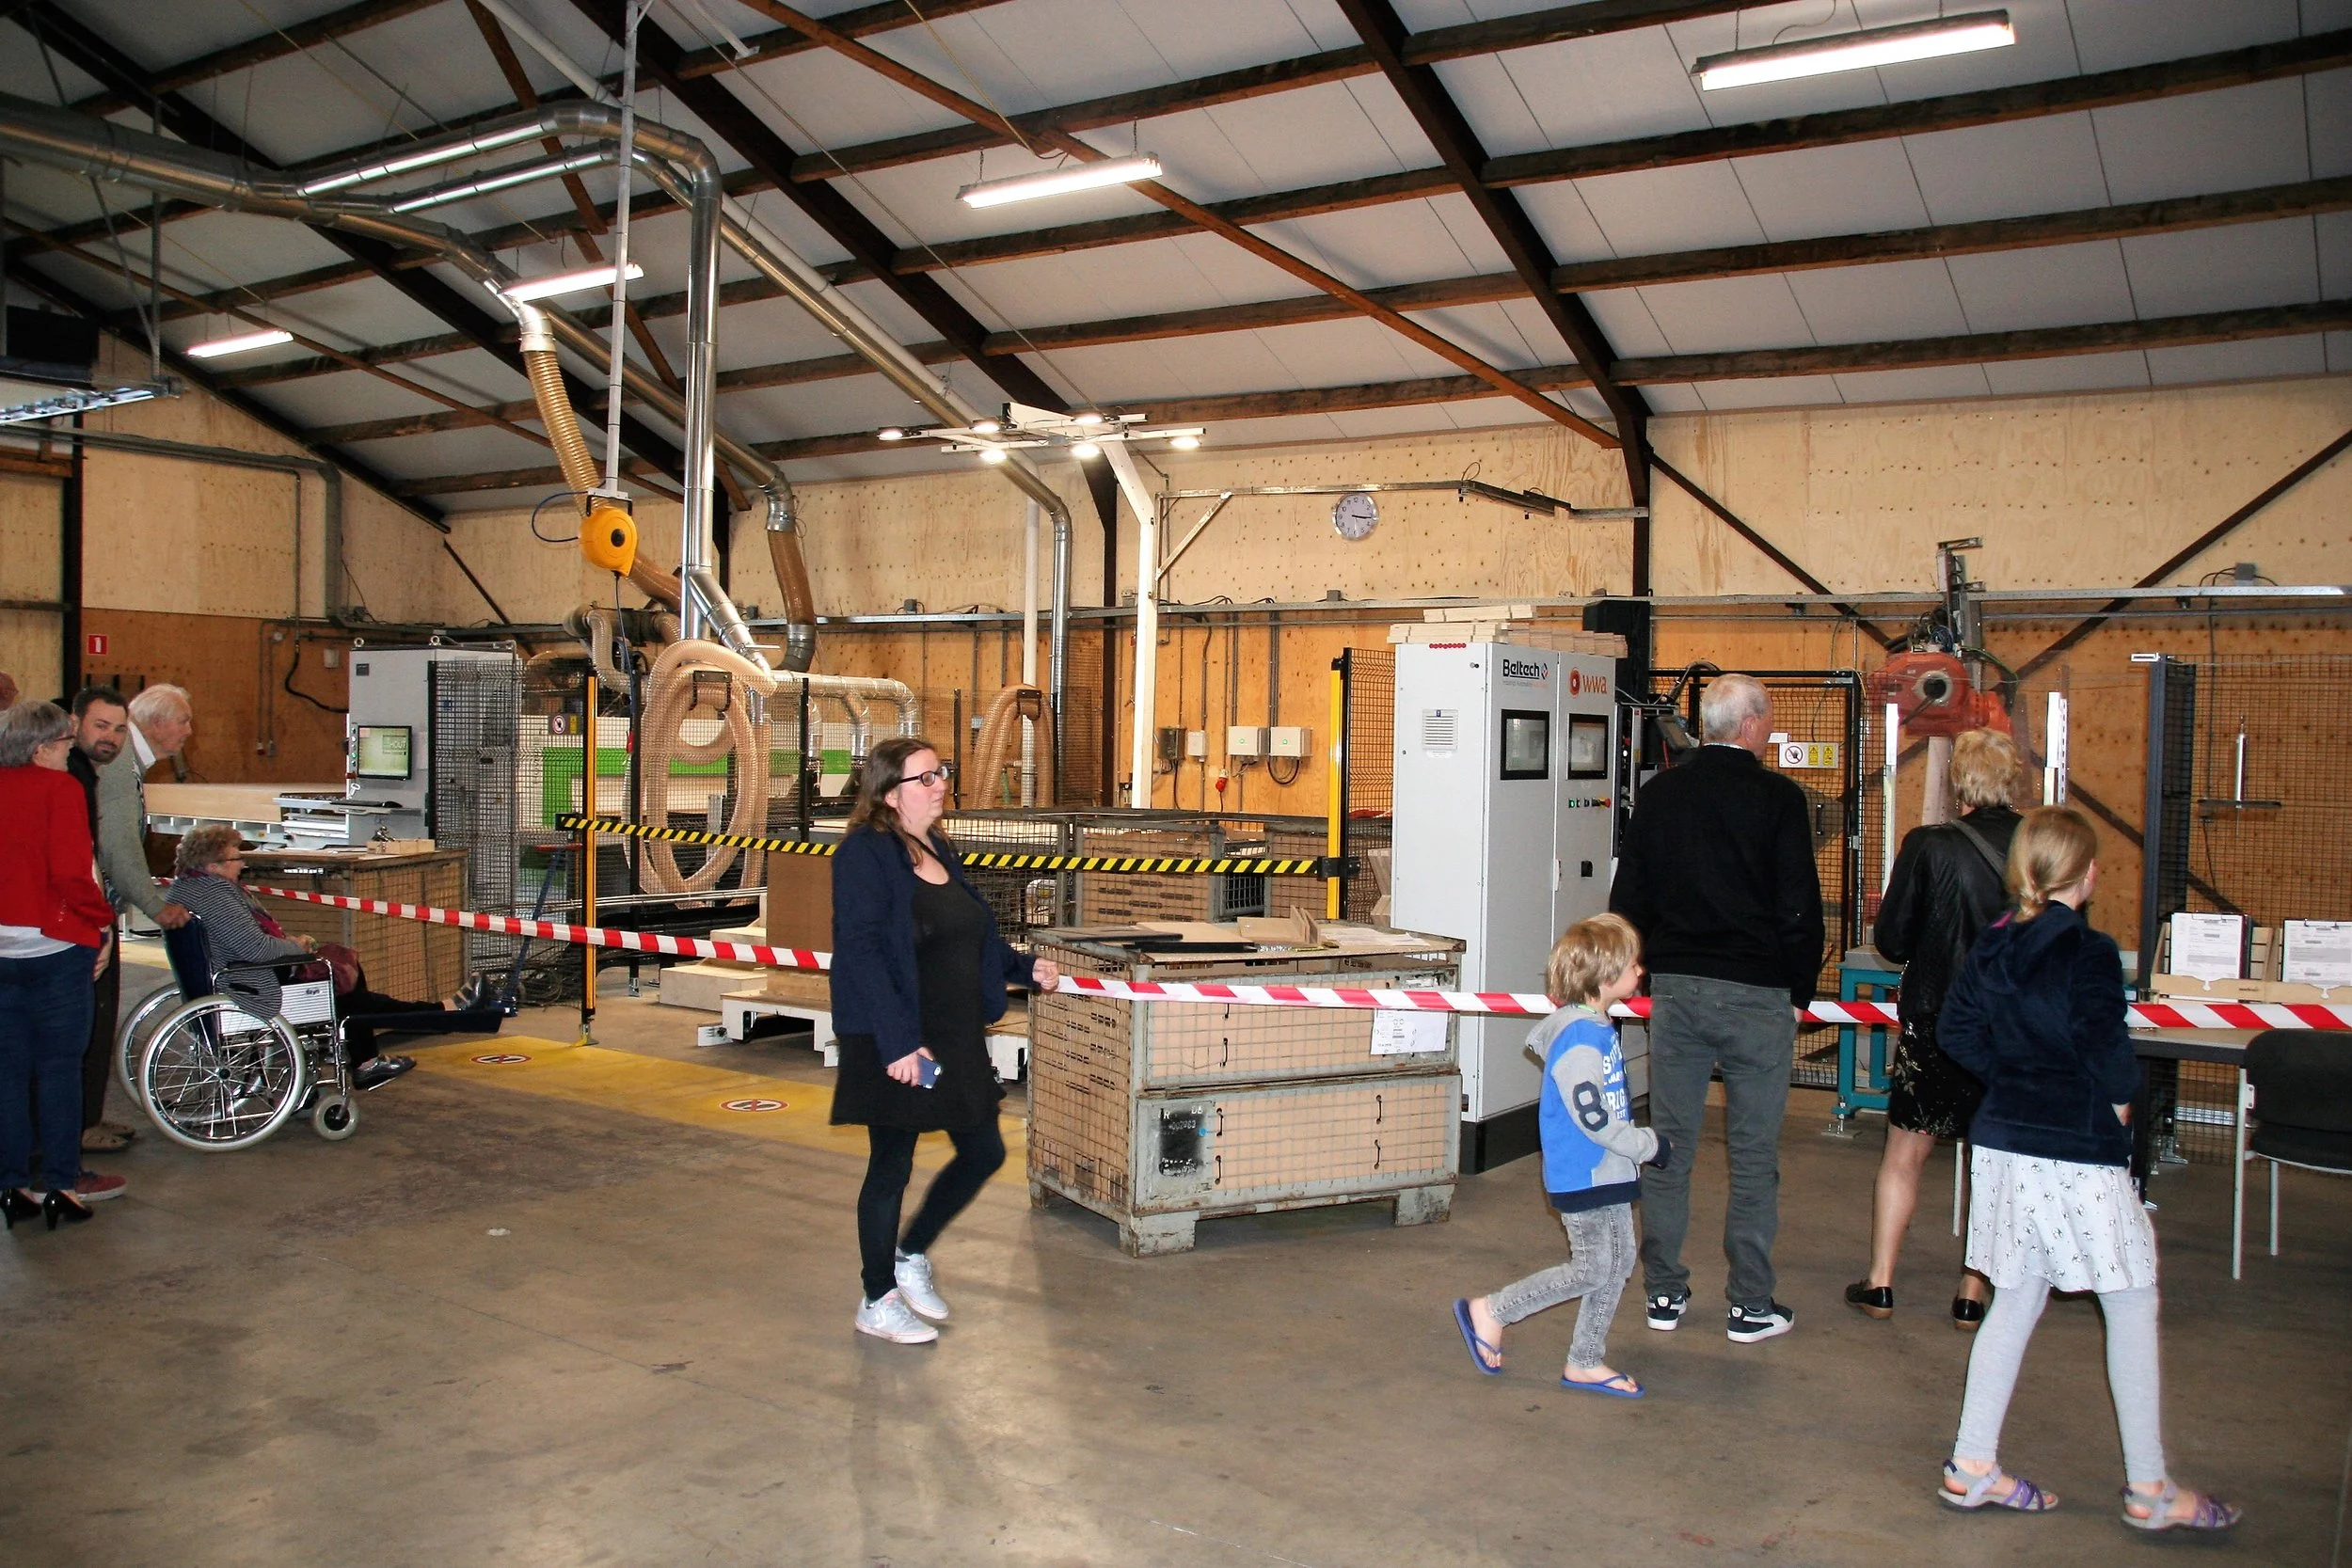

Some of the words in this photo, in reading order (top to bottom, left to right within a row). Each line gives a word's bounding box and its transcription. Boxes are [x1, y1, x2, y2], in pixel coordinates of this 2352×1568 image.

[94, 637, 102, 653] 1
[1502, 658, 1540, 677] Beltech
[1582, 674, 1608, 694] wwa
[1573, 1081, 1608, 1132] 8
